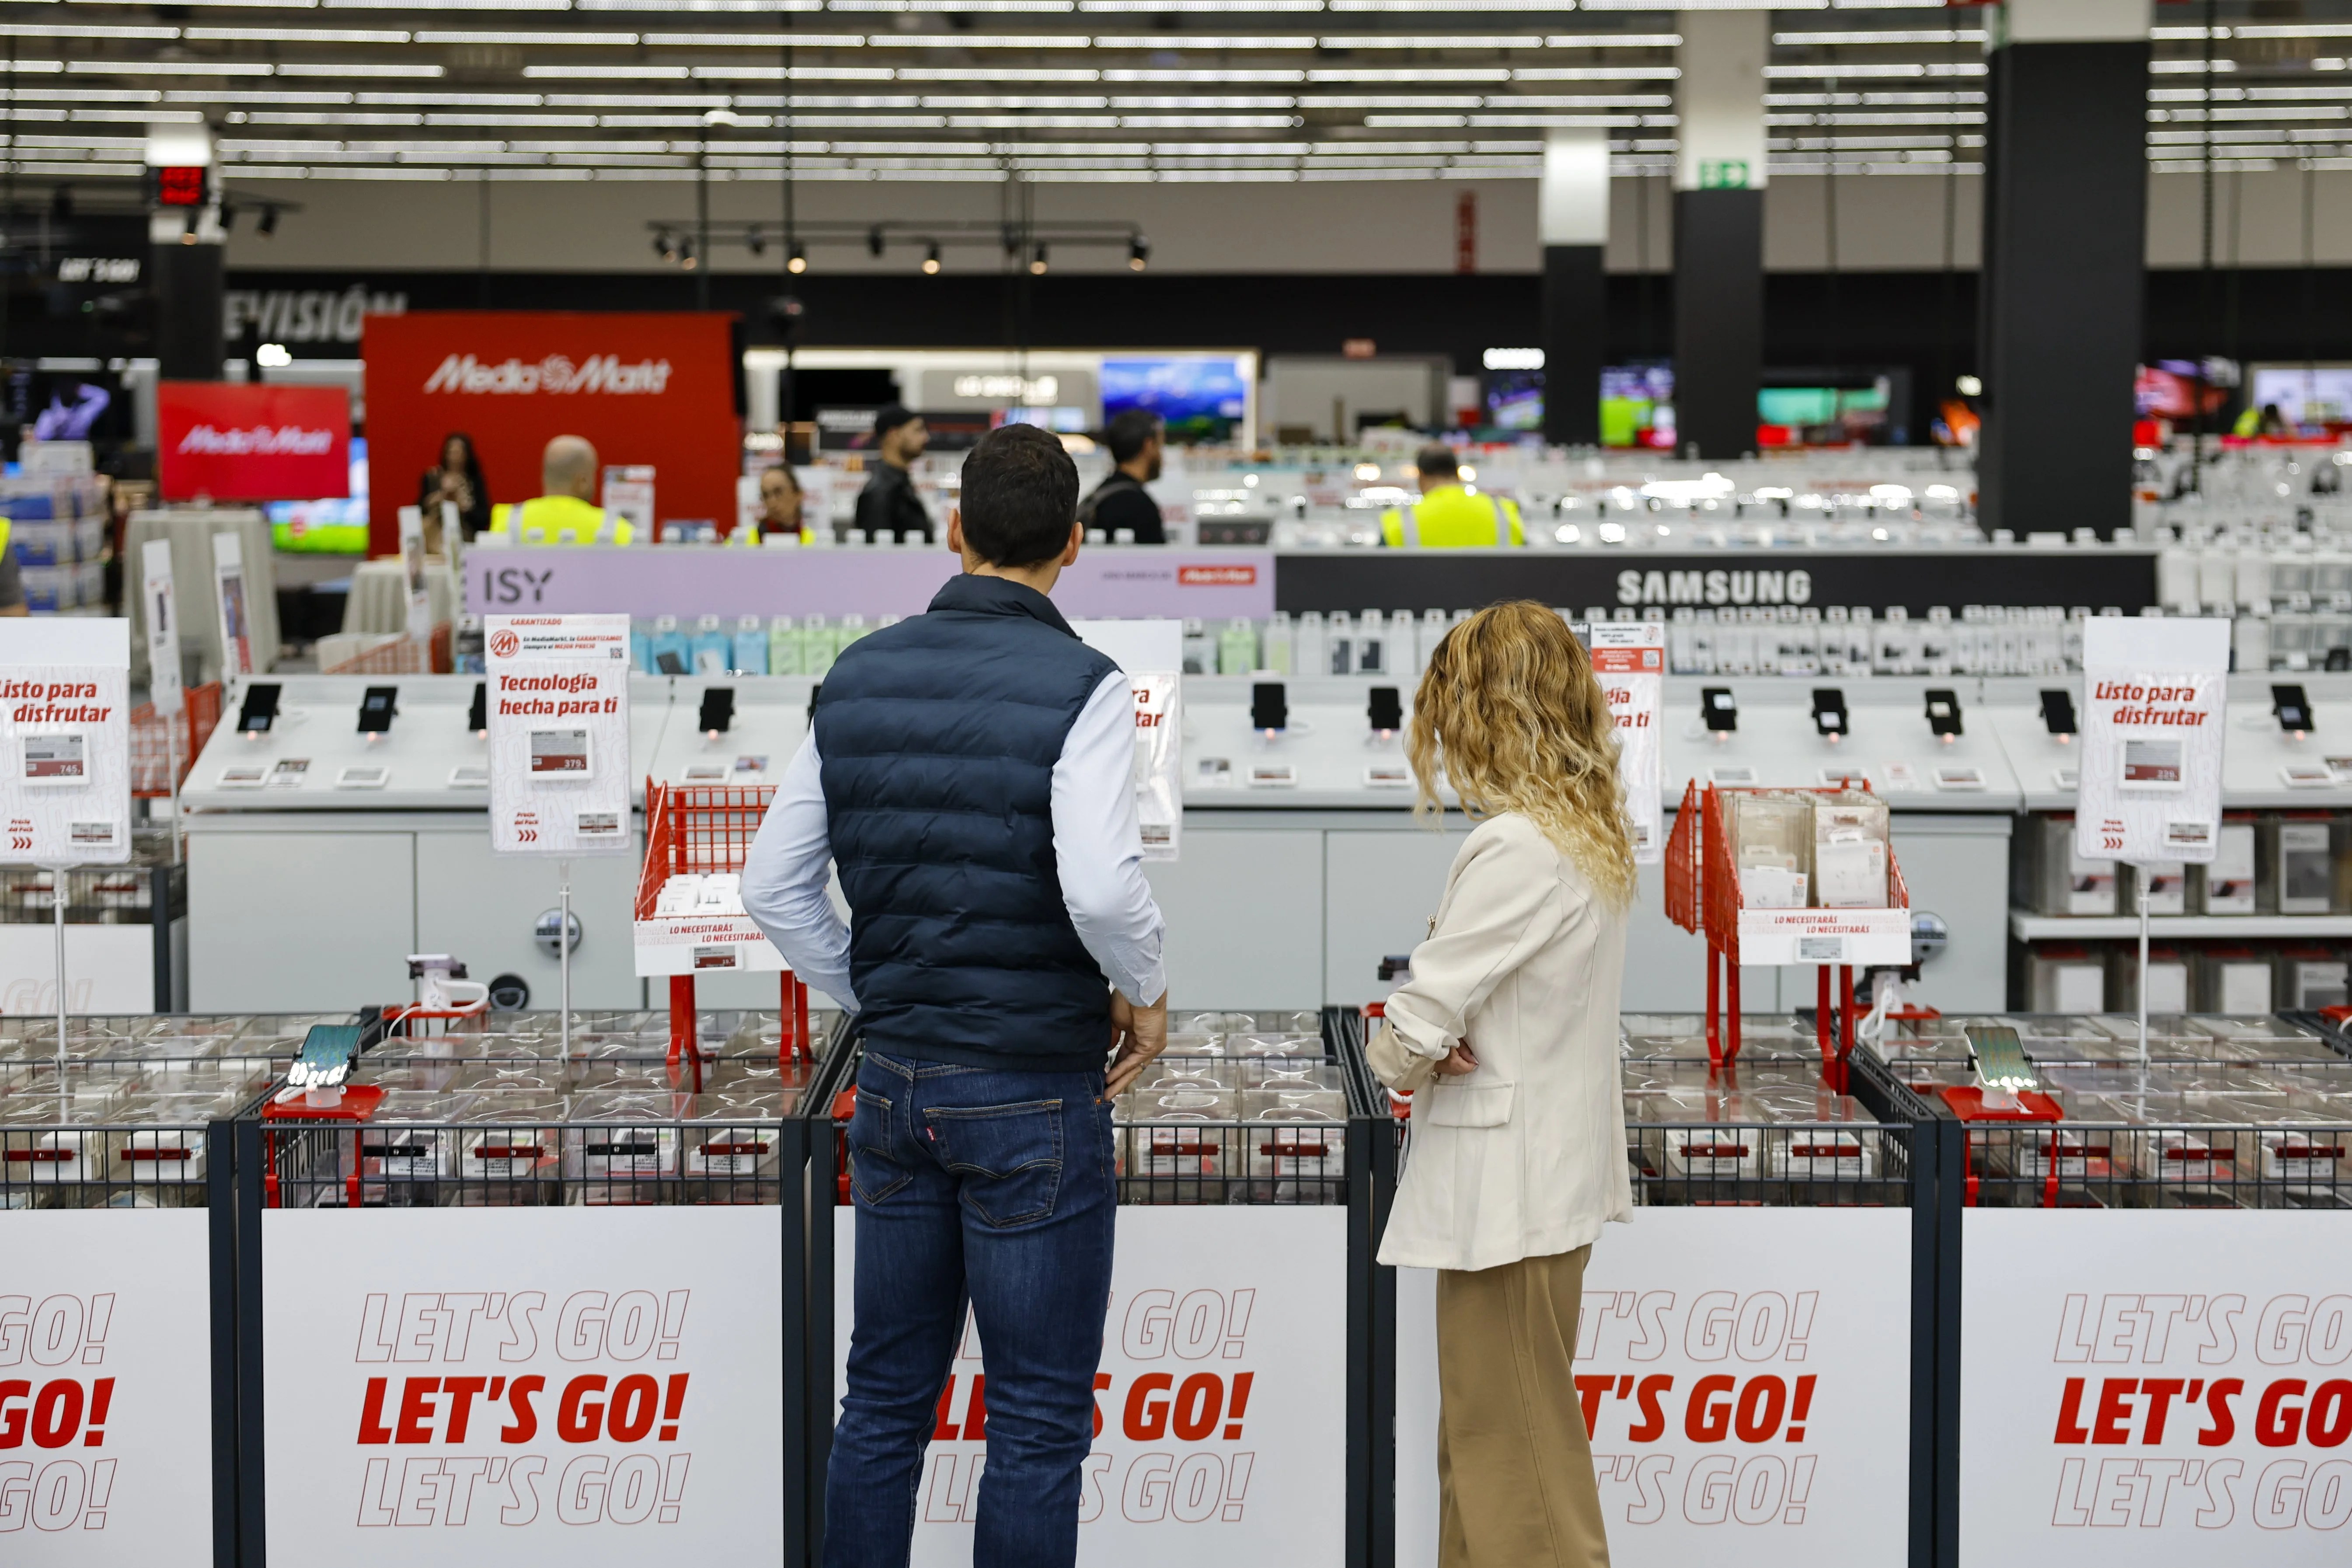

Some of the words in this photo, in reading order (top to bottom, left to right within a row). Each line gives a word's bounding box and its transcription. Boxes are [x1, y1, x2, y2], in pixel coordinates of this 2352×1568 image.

[484, 568, 554, 604] ISY
[1617, 569, 1812, 605] SAMSUNG
[0, 679, 44, 698] isto
[46, 683, 97, 702] para
[14, 703, 112, 722] disfrutar
[499, 673, 598, 693] Tecnología
[499, 697, 554, 714] hecha
[558, 700, 599, 717] para
[603, 697, 618, 713] ti
[2095, 680, 2143, 700] Listo
[2146, 686, 2195, 704] para
[2113, 705, 2209, 726] disfrutar
[1637, 711, 1650, 727] ti
[670, 926, 678, 934] LO
[681, 923, 733, 934] NECESITARÁS
[702, 934, 711, 942] LO
[714, 931, 765, 942] NECESITARÁS
[1786, 914, 1838, 923] NECESITARÁS
[1818, 924, 1870, 934] NECESITARÁS
[0, 1293, 115, 1366] GO!
[356, 1291, 546, 1362] LET'S
[556, 1289, 690, 1362] GO!
[1122, 1288, 1256, 1360] GO!
[1684, 1290, 1819, 1362] GO!
[2053, 1293, 2247, 1366] LET'S
[0, 1377, 115, 1449] GO!
[357, 1375, 546, 1444] LET'S
[557, 1373, 690, 1443] GO!
[1122, 1371, 1255, 1442] GO!
[1684, 1374, 1818, 1443] GO!
[2054, 1377, 2245, 1447] LET'S
[0, 1458, 117, 1532] GO!
[357, 1455, 547, 1526] LET'S
[557, 1453, 691, 1525] GO!
[1122, 1452, 1255, 1523] GO!
[1683, 1454, 1818, 1525] GO!
[2052, 1457, 2244, 1529] LET'S
